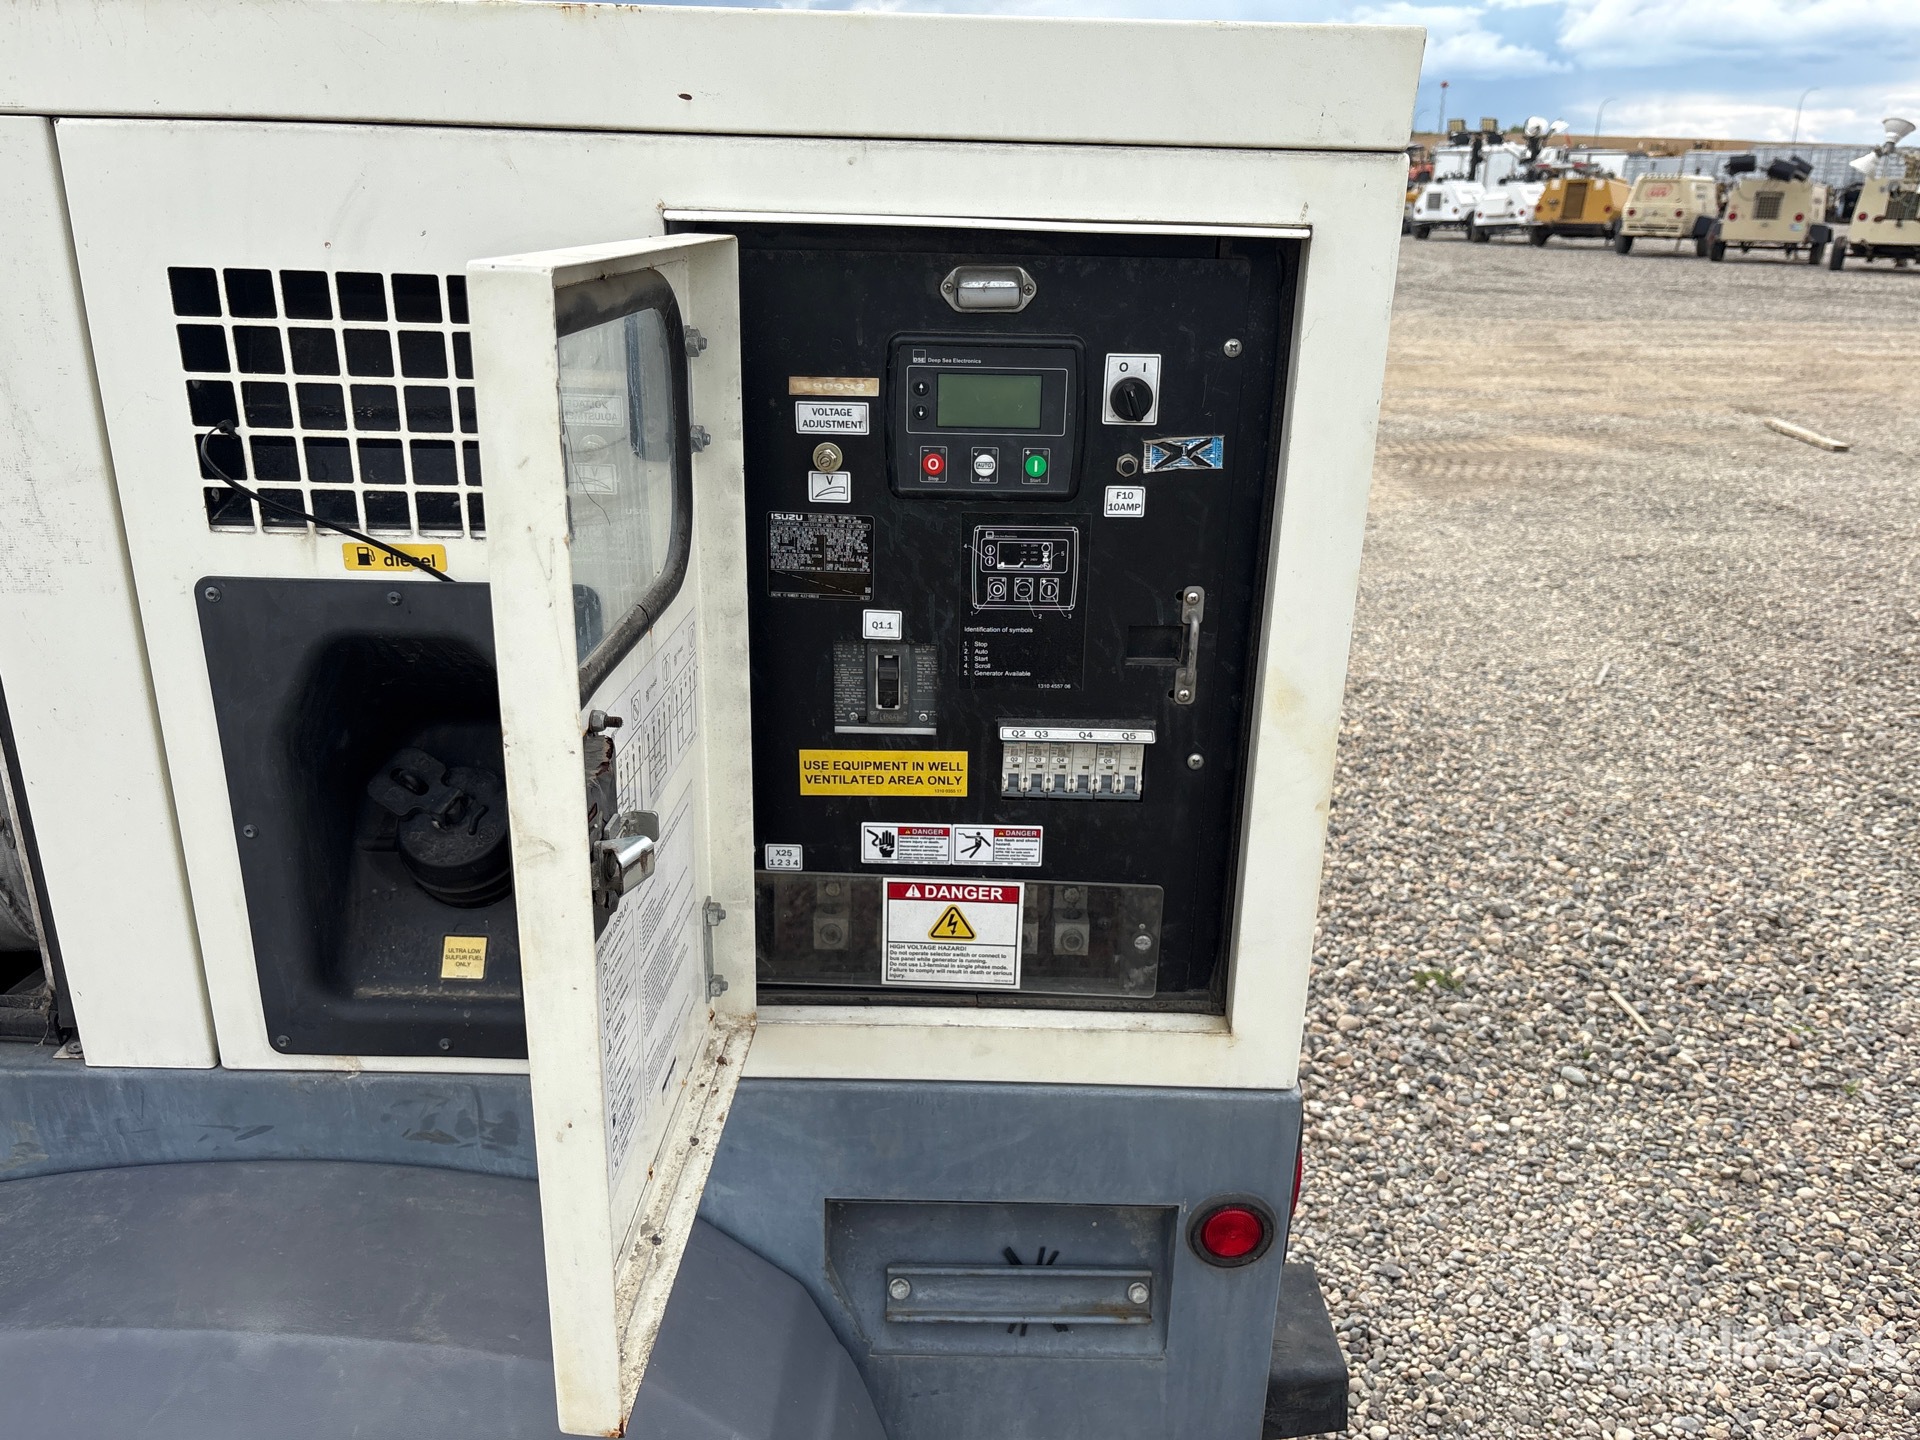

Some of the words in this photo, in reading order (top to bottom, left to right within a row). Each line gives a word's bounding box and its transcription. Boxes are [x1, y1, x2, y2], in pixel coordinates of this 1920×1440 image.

[812, 407, 852, 417] VOLTAGE
[802, 419, 863, 429] ADJUSTMENT
[826, 476, 833, 485] V
[1116, 491, 1134, 500] F10
[1108, 502, 1141, 512] 10AMP
[872, 622, 893, 630] Q1.1
[803, 760, 829, 770] USE
[833, 761, 908, 771] EQUIPMENT
[912, 762, 924, 771] IN
[928, 762, 963, 771] WELL
[805, 774, 884, 785] VENTILATED
[888, 776, 923, 785] AREA
[928, 776, 963, 785] ONLY
[924, 885, 1003, 900] DANGER
